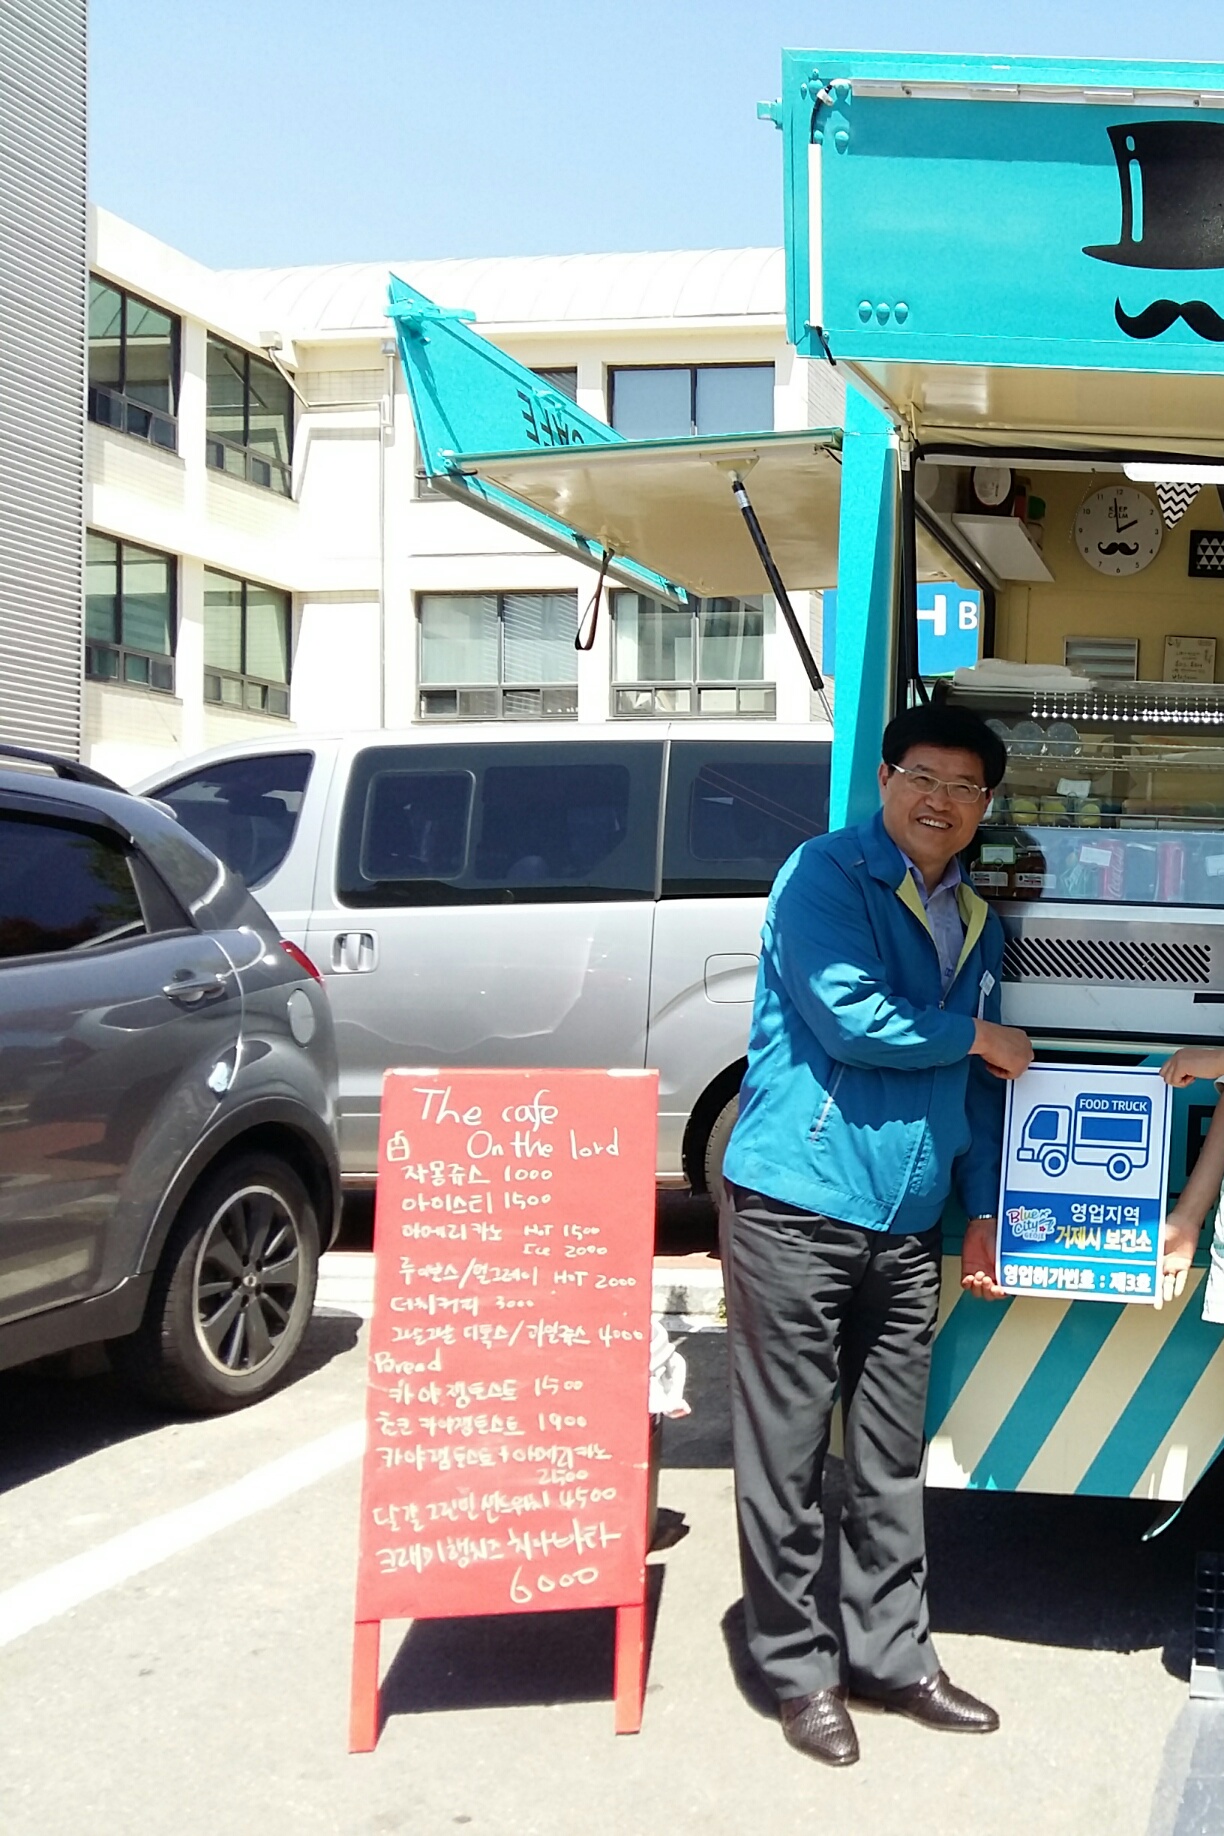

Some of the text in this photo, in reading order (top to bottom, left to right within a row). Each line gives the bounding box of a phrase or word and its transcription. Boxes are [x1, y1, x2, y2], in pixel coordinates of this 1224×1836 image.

[413, 1086, 558, 1131] The cafe
[1079, 1098, 1148, 1113] FOOD TRUCK
[466, 1127, 619, 1160] On the lord
[503, 1165, 553, 1182] 1000
[401, 1190, 552, 1214] 아이스티 1500
[1007, 1207, 1042, 1224] Blue
[1070, 1202, 1142, 1226] 영업지역
[402, 1220, 503, 1242] 아메리카노
[563, 1223, 601, 1241] 1500
[1012, 1218, 1041, 1236] City
[564, 1244, 608, 1258] 2000
[1055, 1226, 1154, 1254] 거제시 보건소
[594, 1273, 637, 1289] 2000
[1003, 1264, 1096, 1291] 영업허가번호
[1109, 1271, 1153, 1293] 제3호
[390, 1293, 535, 1317] 더치커피 3000
[598, 1323, 644, 1347] 4000
[373, 1346, 442, 1375] Bread
[534, 1374, 584, 1396] 1500
[538, 1412, 588, 1431] 1900
[537, 1468, 589, 1486] 2500
[560, 1487, 618, 1508] 4500
[509, 1566, 600, 1604] 6000
